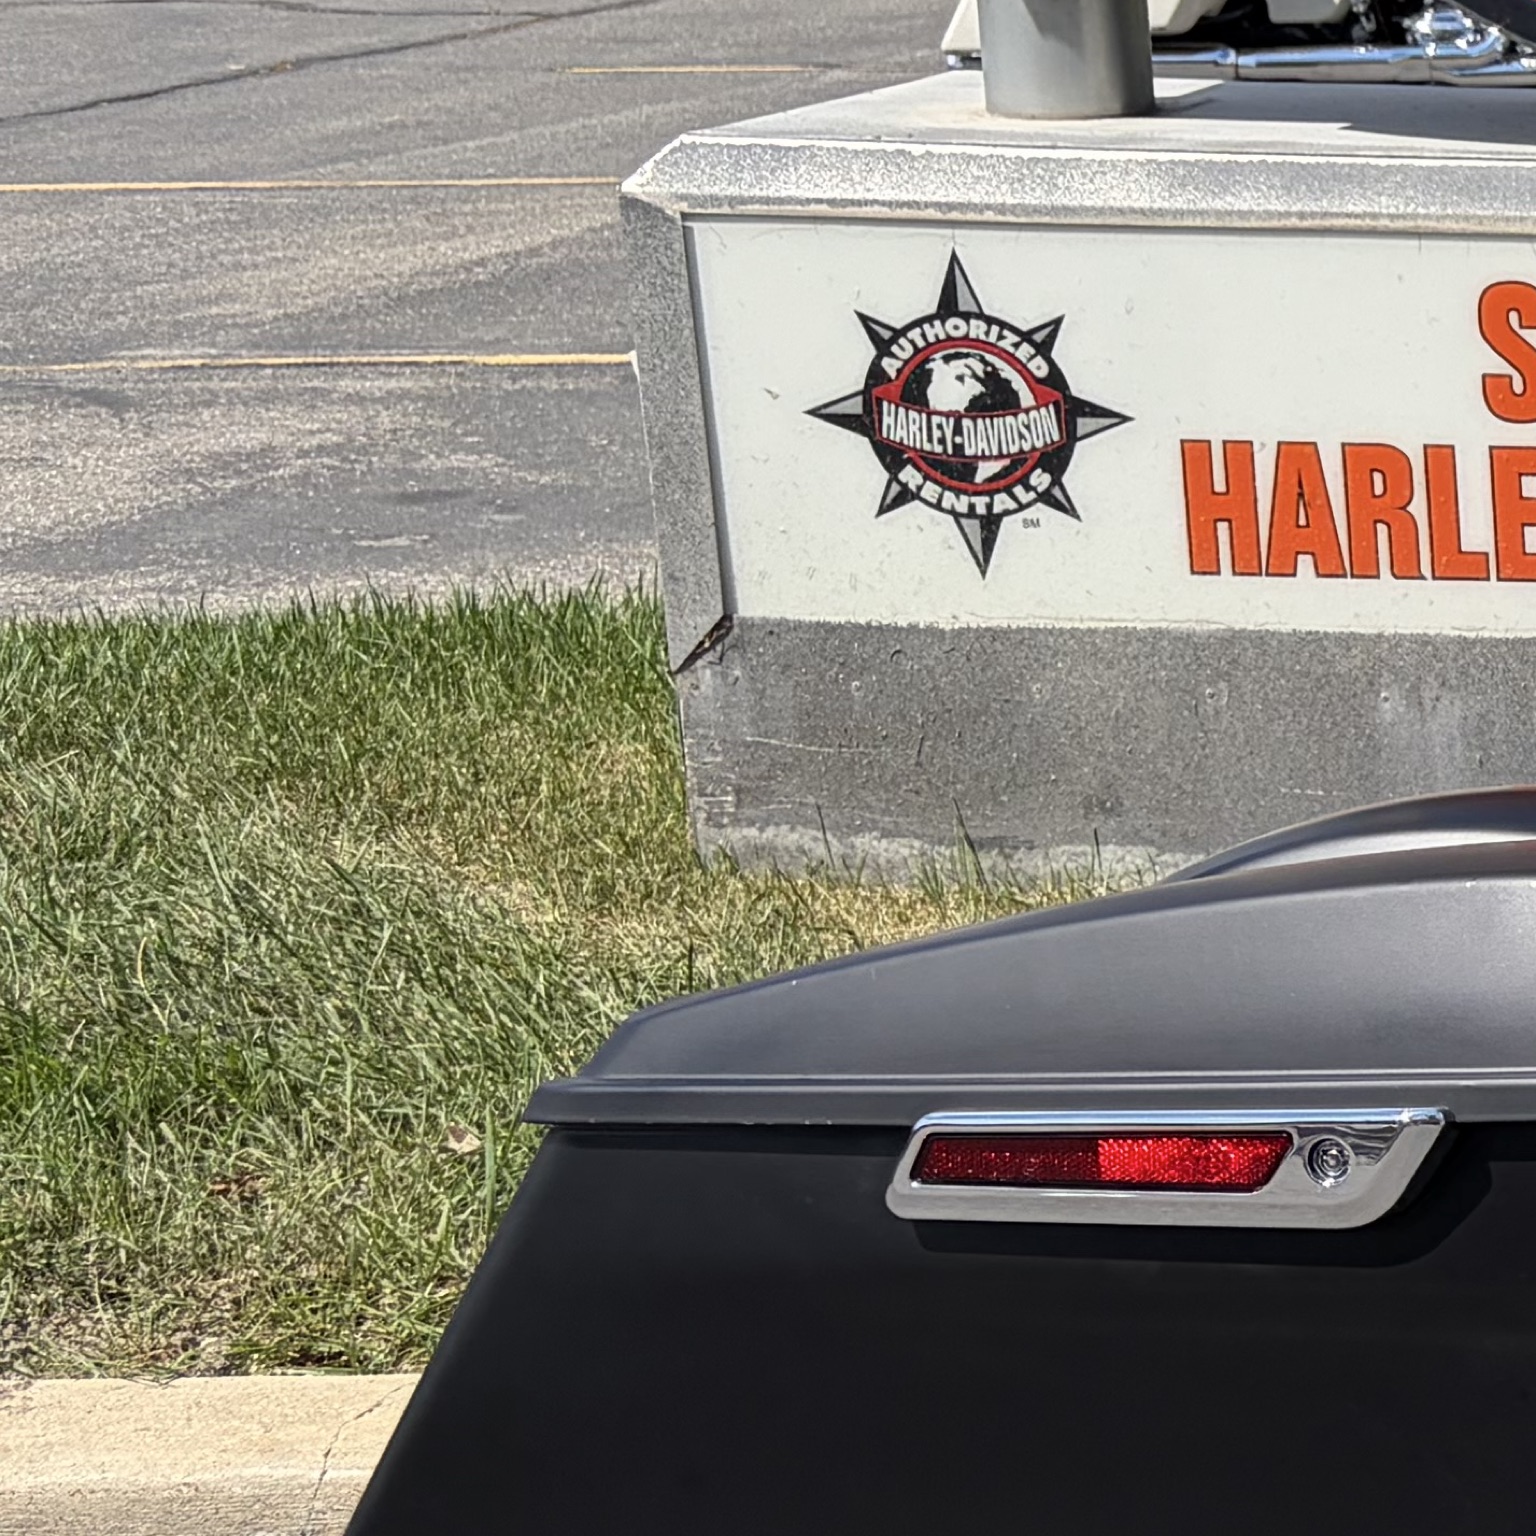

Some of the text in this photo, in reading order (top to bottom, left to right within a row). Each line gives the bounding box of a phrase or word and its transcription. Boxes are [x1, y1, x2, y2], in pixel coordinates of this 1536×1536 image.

[880, 316, 1051, 380] AUTHORIZED
[881, 400, 1059, 457] HARLEY-DAVIDSON
[897, 463, 1052, 515] RENTALS
